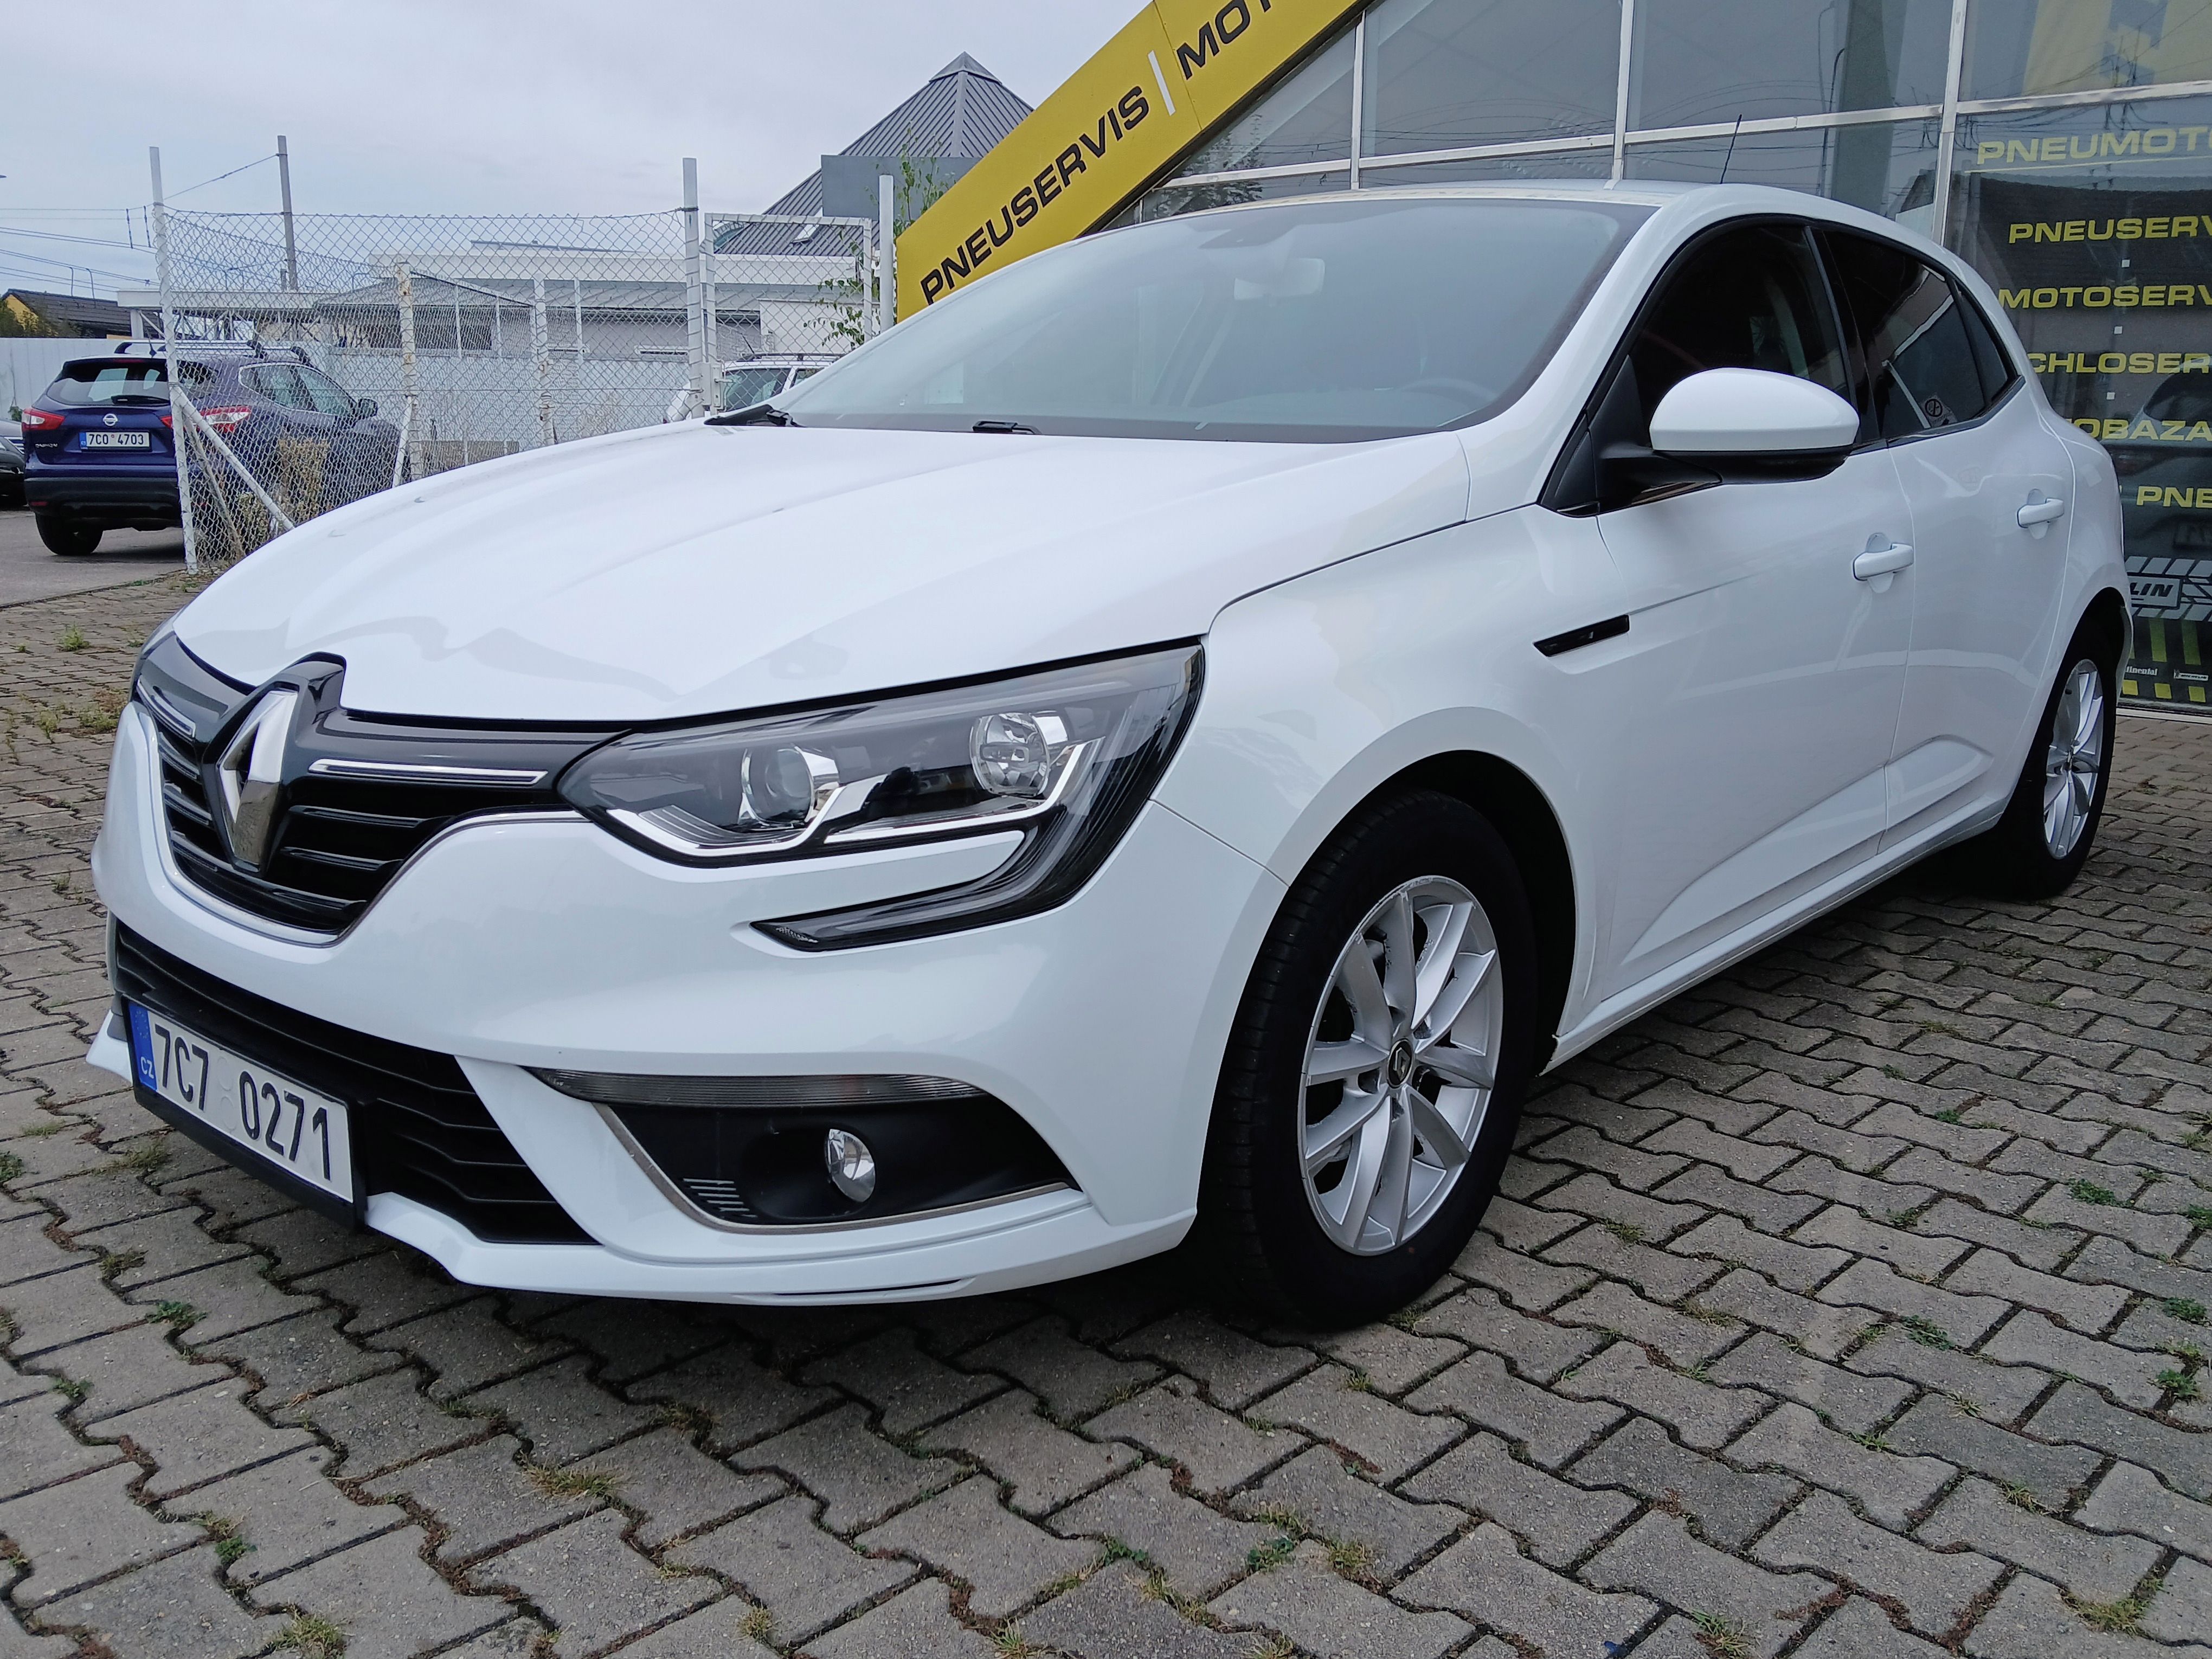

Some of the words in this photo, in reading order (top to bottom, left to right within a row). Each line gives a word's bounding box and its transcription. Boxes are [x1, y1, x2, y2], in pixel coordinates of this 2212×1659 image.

[921, 86, 1149, 305] PNEUSERVIS
[1176, 0, 1271, 80] MO
[1977, 126, 2212, 164] PNEUMOT
[89, 434, 108, 445] 7C0
[118, 434, 144, 445] 4703
[2067, 418, 2212, 441] OBAZA
[2137, 486, 2212, 508] PNE
[140, 1056, 154, 1079] CZ
[155, 1024, 209, 1111] 7C7
[239, 1071, 331, 1181] 0271
